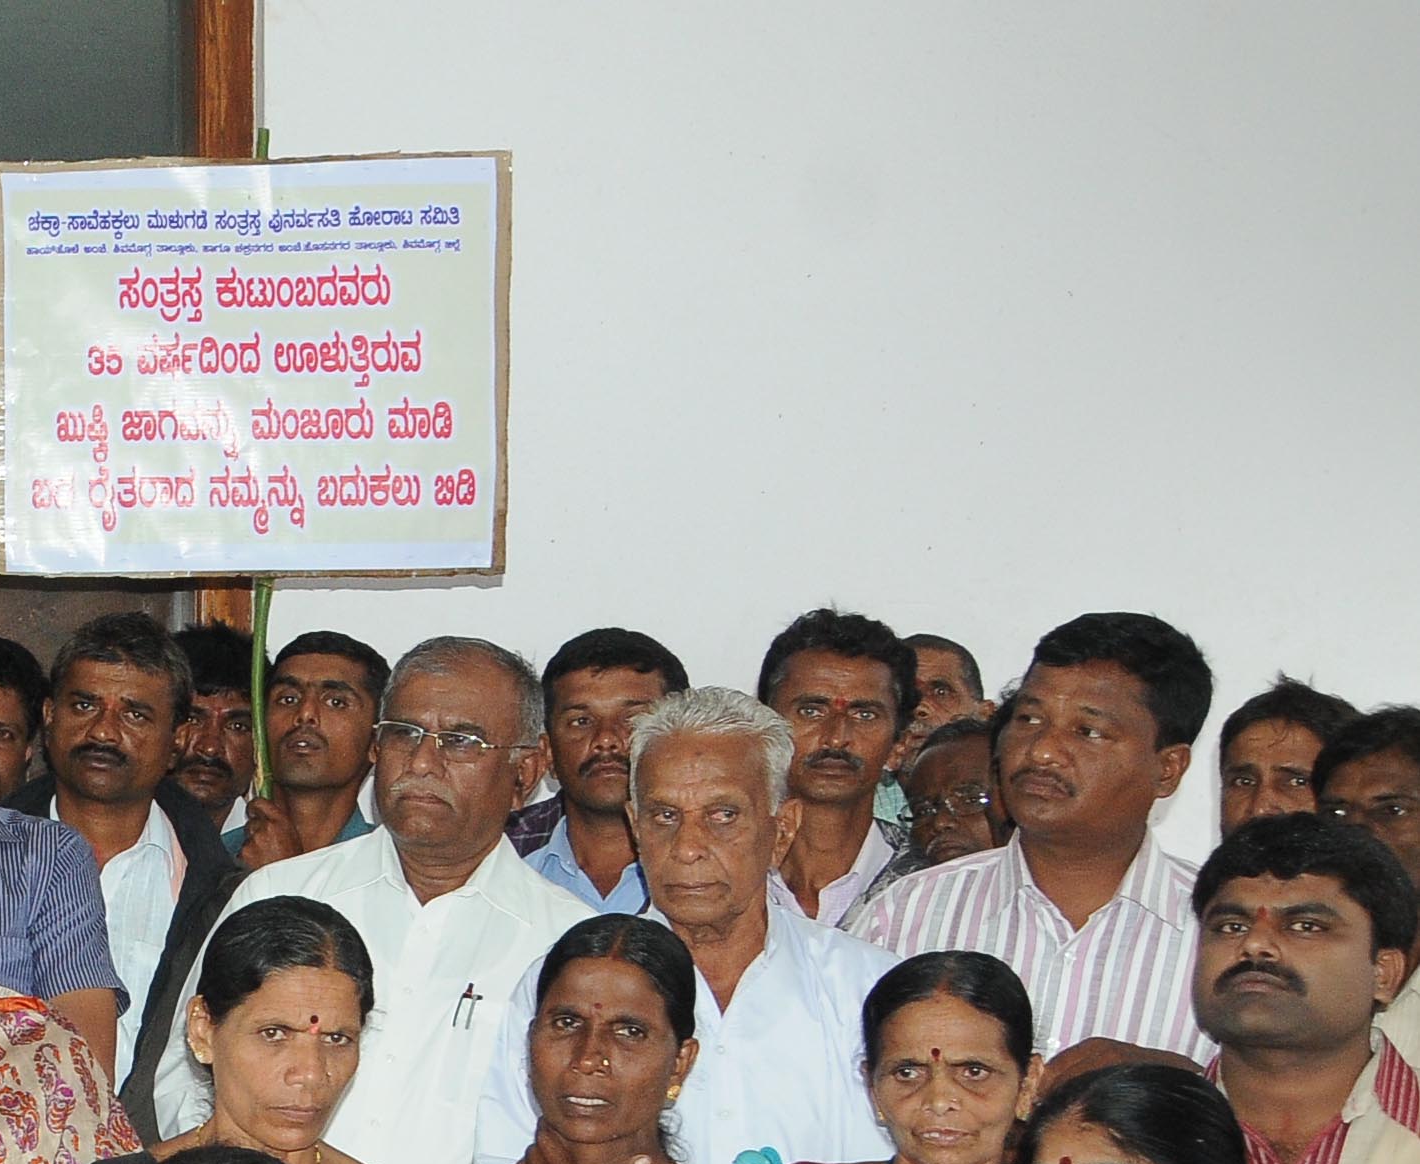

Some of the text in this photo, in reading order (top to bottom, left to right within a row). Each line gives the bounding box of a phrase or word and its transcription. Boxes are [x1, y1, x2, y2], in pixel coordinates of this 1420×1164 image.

[348, 205, 413, 228] ಹೋರಾಟ
[420, 204, 460, 227] ಸಮಿತಿ
[118, 263, 392, 323] ಸಂತ್ರಸ್ತ ಕುಟುಂಬದವರು
[251, 397, 375, 440] ಮಂಜೂರು
[388, 396, 454, 439] ಮಾಡಿ
[209, 464, 306, 535] ನಮ್ಮನ್ನು
[317, 463, 422, 506] ಬದುಕಲು
[434, 468, 477, 506] ಬಿಡಿ
